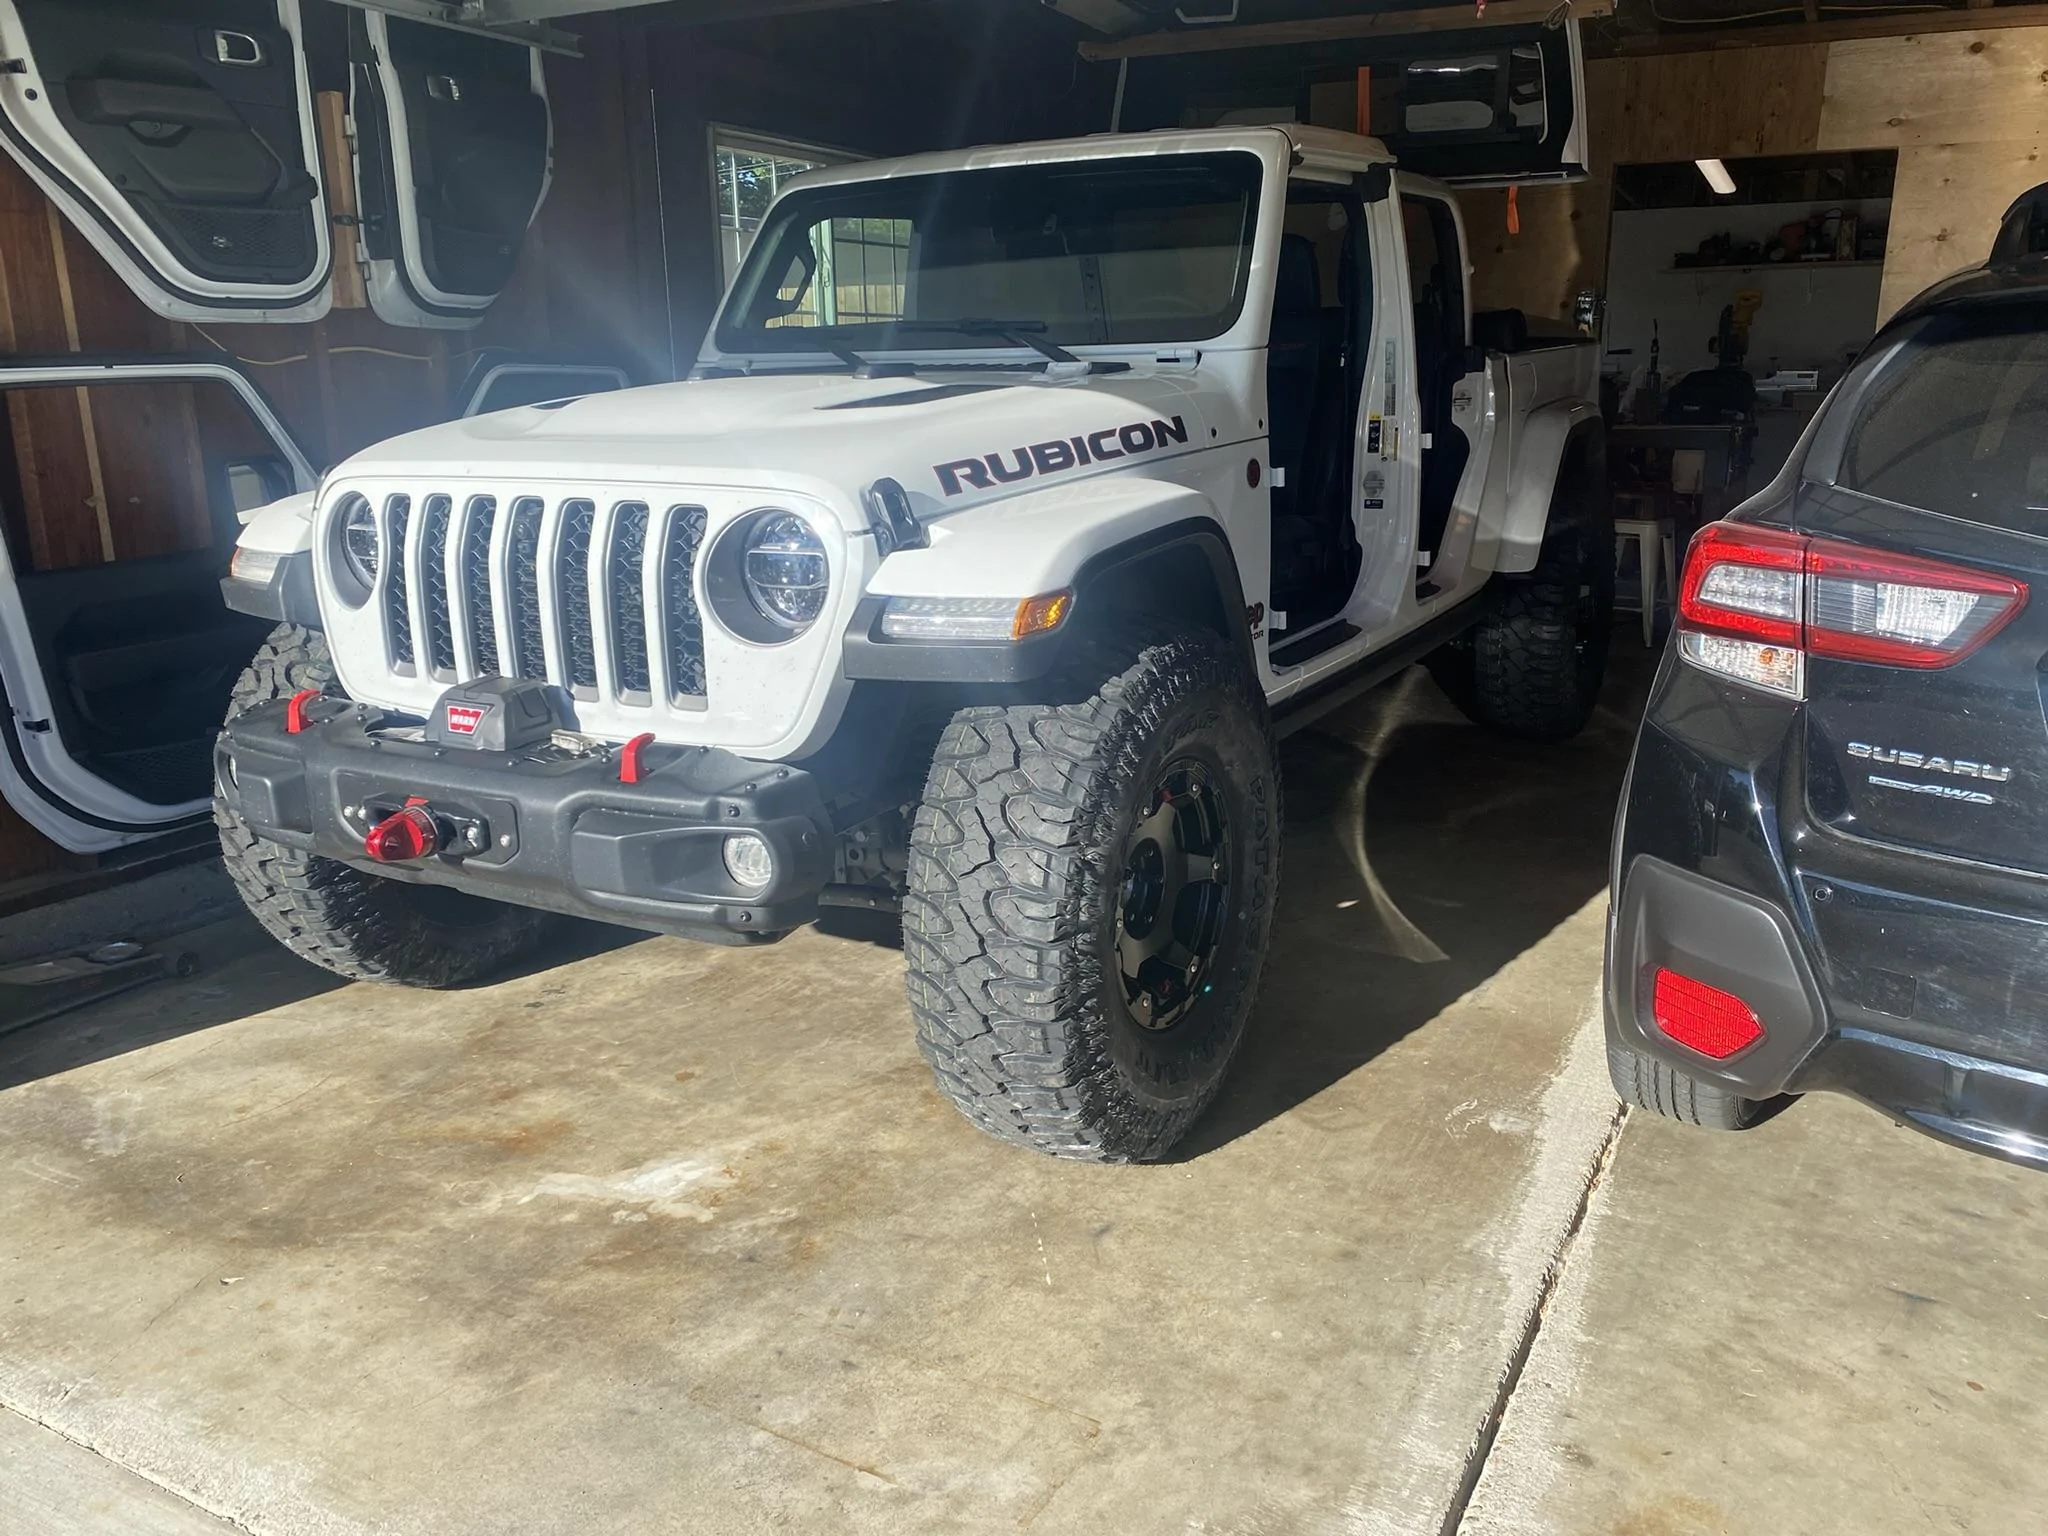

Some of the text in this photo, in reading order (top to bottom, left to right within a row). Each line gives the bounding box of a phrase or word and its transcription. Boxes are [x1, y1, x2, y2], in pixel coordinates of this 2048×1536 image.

[933, 415, 1188, 497] RUBICON
[451, 714, 477, 727] WARN
[1847, 742, 2010, 782] SUBARU
